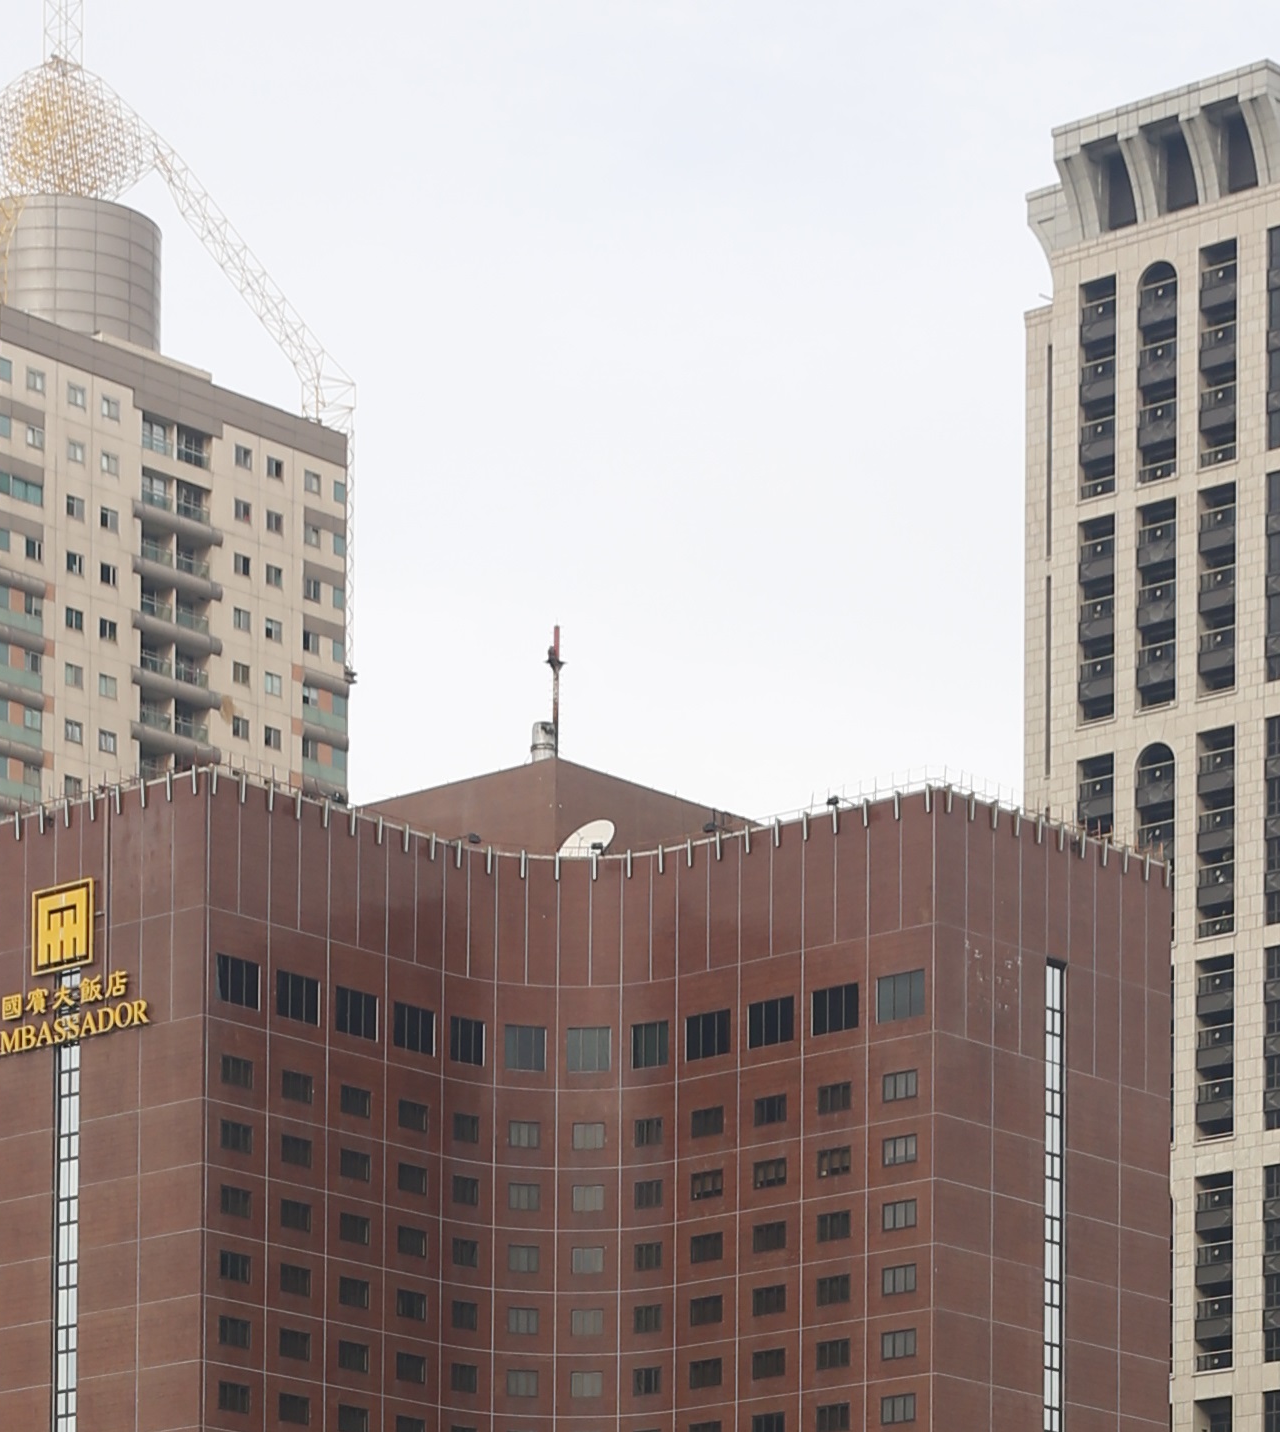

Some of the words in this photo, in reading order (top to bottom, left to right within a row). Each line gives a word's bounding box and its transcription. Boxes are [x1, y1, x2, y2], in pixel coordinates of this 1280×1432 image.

[2, 971, 128, 1020] 國賓大飯店
